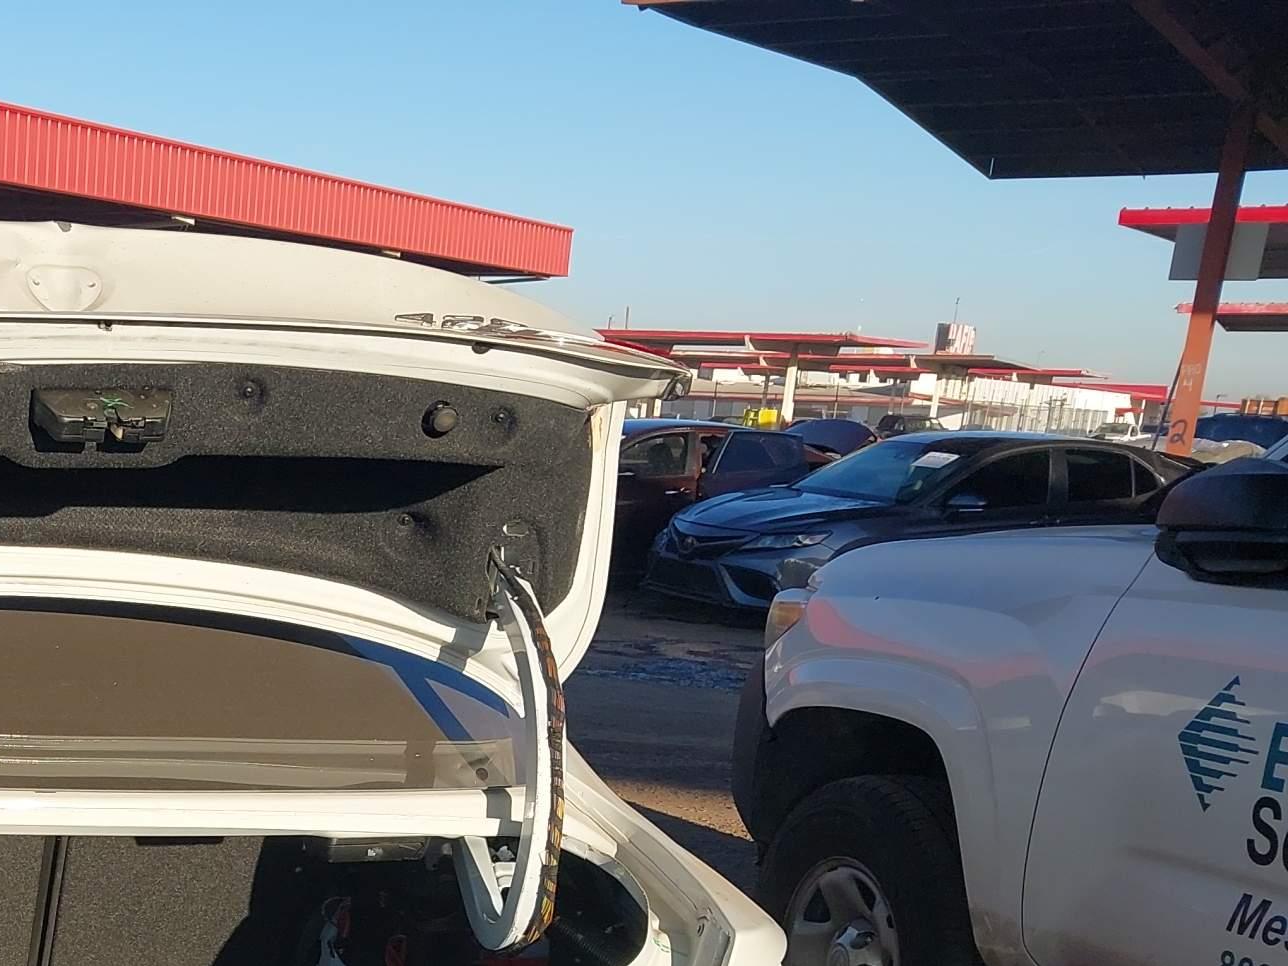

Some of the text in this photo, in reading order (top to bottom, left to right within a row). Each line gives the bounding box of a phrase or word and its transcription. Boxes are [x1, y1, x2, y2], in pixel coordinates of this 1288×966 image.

[1169, 419, 1188, 446] 2
[1246, 796, 1288, 873] S
[1225, 892, 1288, 952] Me
